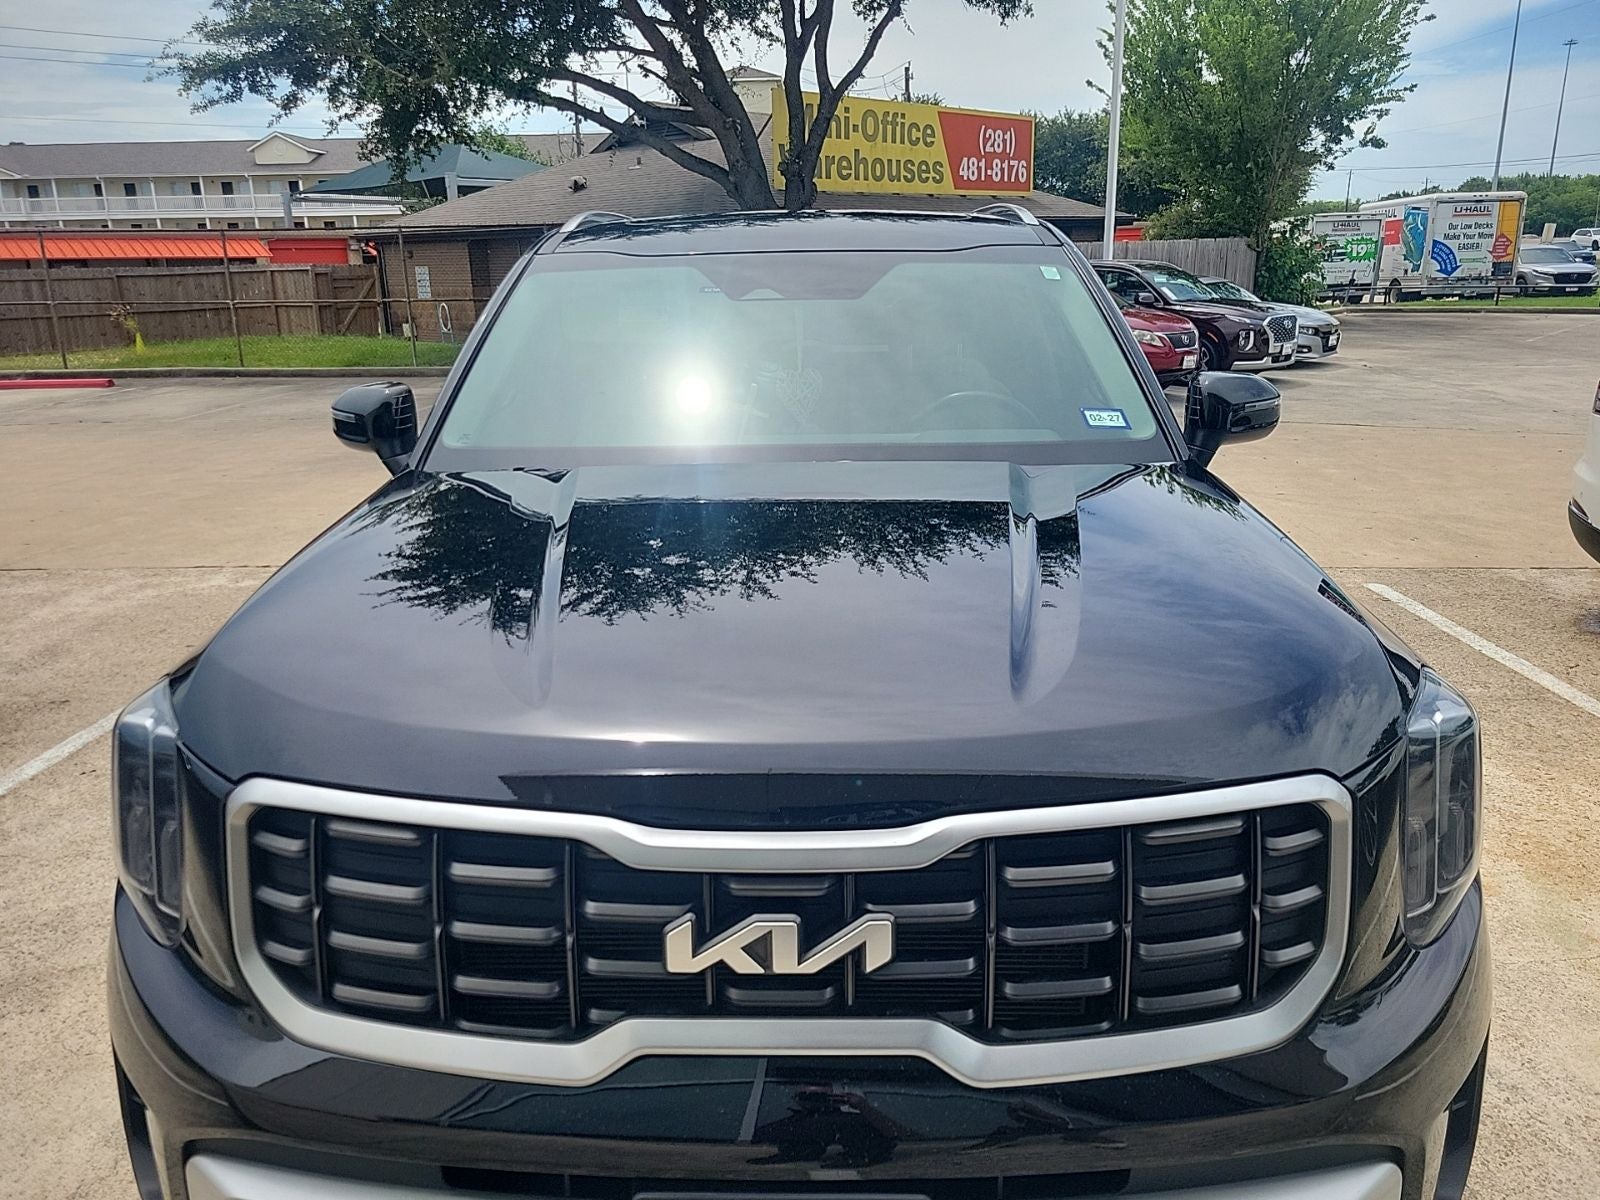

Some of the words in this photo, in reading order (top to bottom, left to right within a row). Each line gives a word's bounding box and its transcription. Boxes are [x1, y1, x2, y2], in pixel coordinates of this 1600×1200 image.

[979, 125, 1016, 157] (281)
[959, 157, 1027, 183] 481-8176
[1454, 206, 1492, 214] U-HAUL
[1460, 222, 1473, 230] Low
[1477, 232, 1494, 240] Move
[1458, 243, 1483, 251] EASIER!
